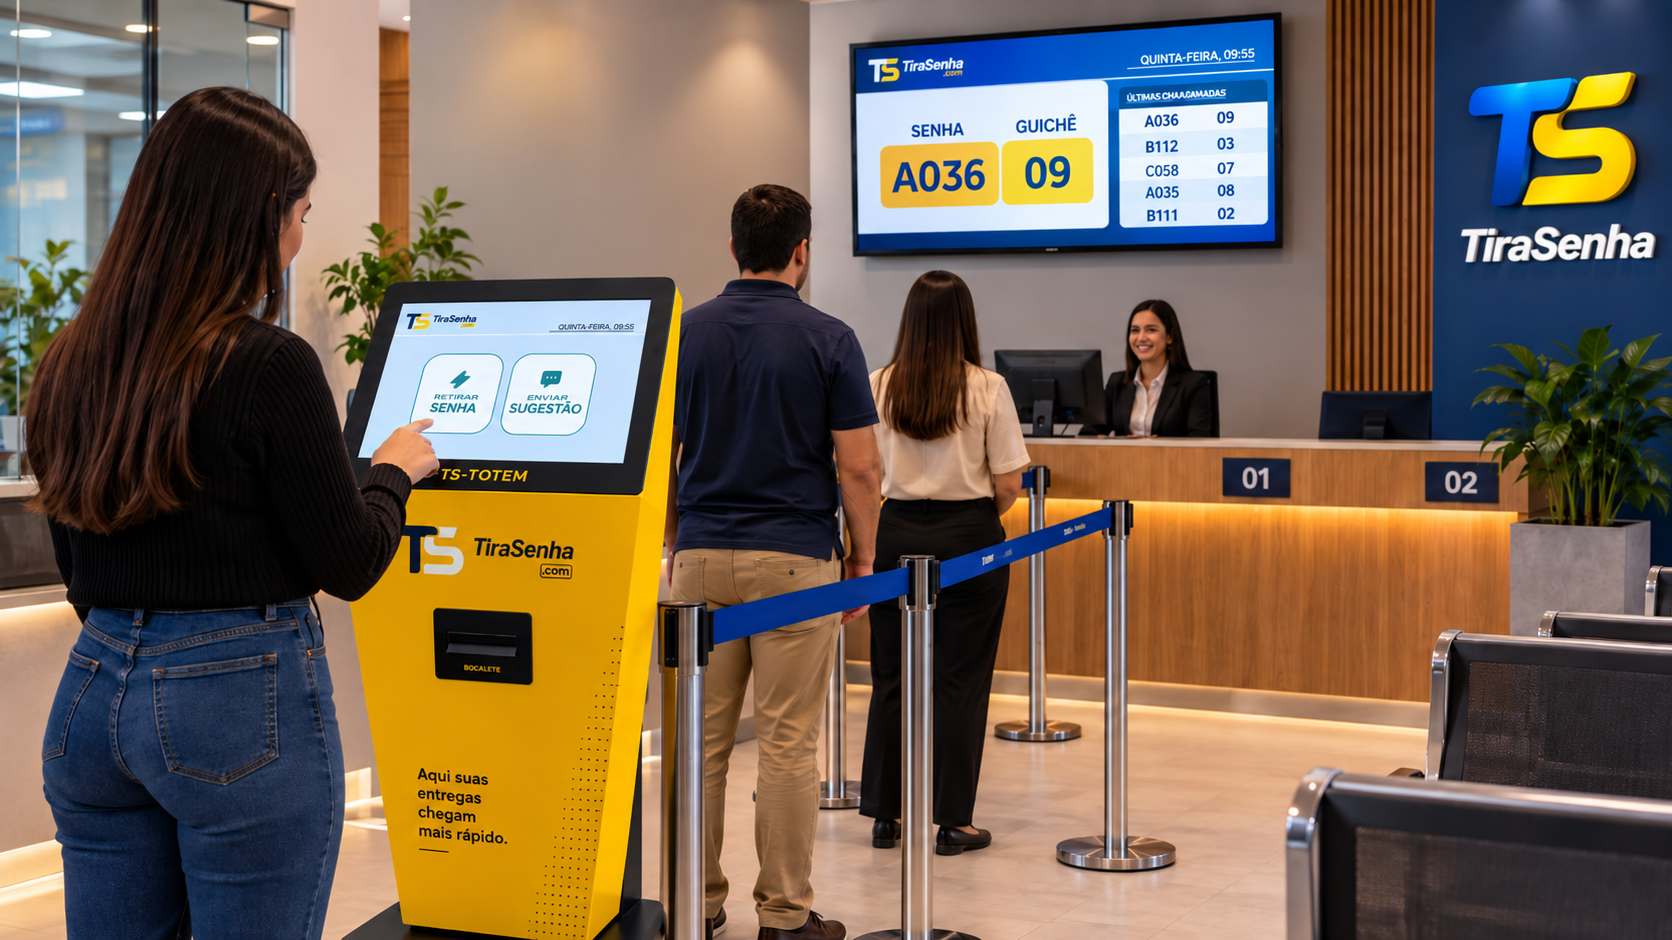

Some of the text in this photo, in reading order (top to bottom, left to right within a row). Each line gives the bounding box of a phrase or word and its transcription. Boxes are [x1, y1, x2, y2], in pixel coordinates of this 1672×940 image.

[1140, 48, 1255, 65] QUINTA-FEIRA, 09:55
[868, 57, 964, 83] TS TiraSenha
[1015, 113, 1077, 134] GUICHÊ
[1144, 110, 1235, 128] A036 09
[911, 122, 964, 138] SENHA
[1468, 71, 1636, 206] TS
[1145, 137, 1235, 153] B112 03
[891, 158, 986, 193] A036
[1024, 155, 1071, 190] 09
[1145, 162, 1235, 177] C058 07
[1145, 184, 1235, 199] A035 08
[1146, 207, 1235, 222] B111 02
[1460, 223, 1656, 263] TiraSenha
[406, 313, 477, 330] TS TiraSenha
[429, 402, 476, 413] SENHA
[509, 401, 582, 414] SUGESTÃO
[441, 468, 529, 482] TS-TOTEM
[1241, 466, 1269, 490] 01
[1444, 470, 1478, 494] 02
[402, 525, 574, 576] TS TiraSenha
[541, 565, 570, 576] .com
[463, 664, 501, 674] BOCALETE
[417, 768, 489, 786] Aqui suas
[417, 789, 482, 806] entregas
[418, 805, 476, 823] chegam
[419, 826, 508, 845] mais rápido.
